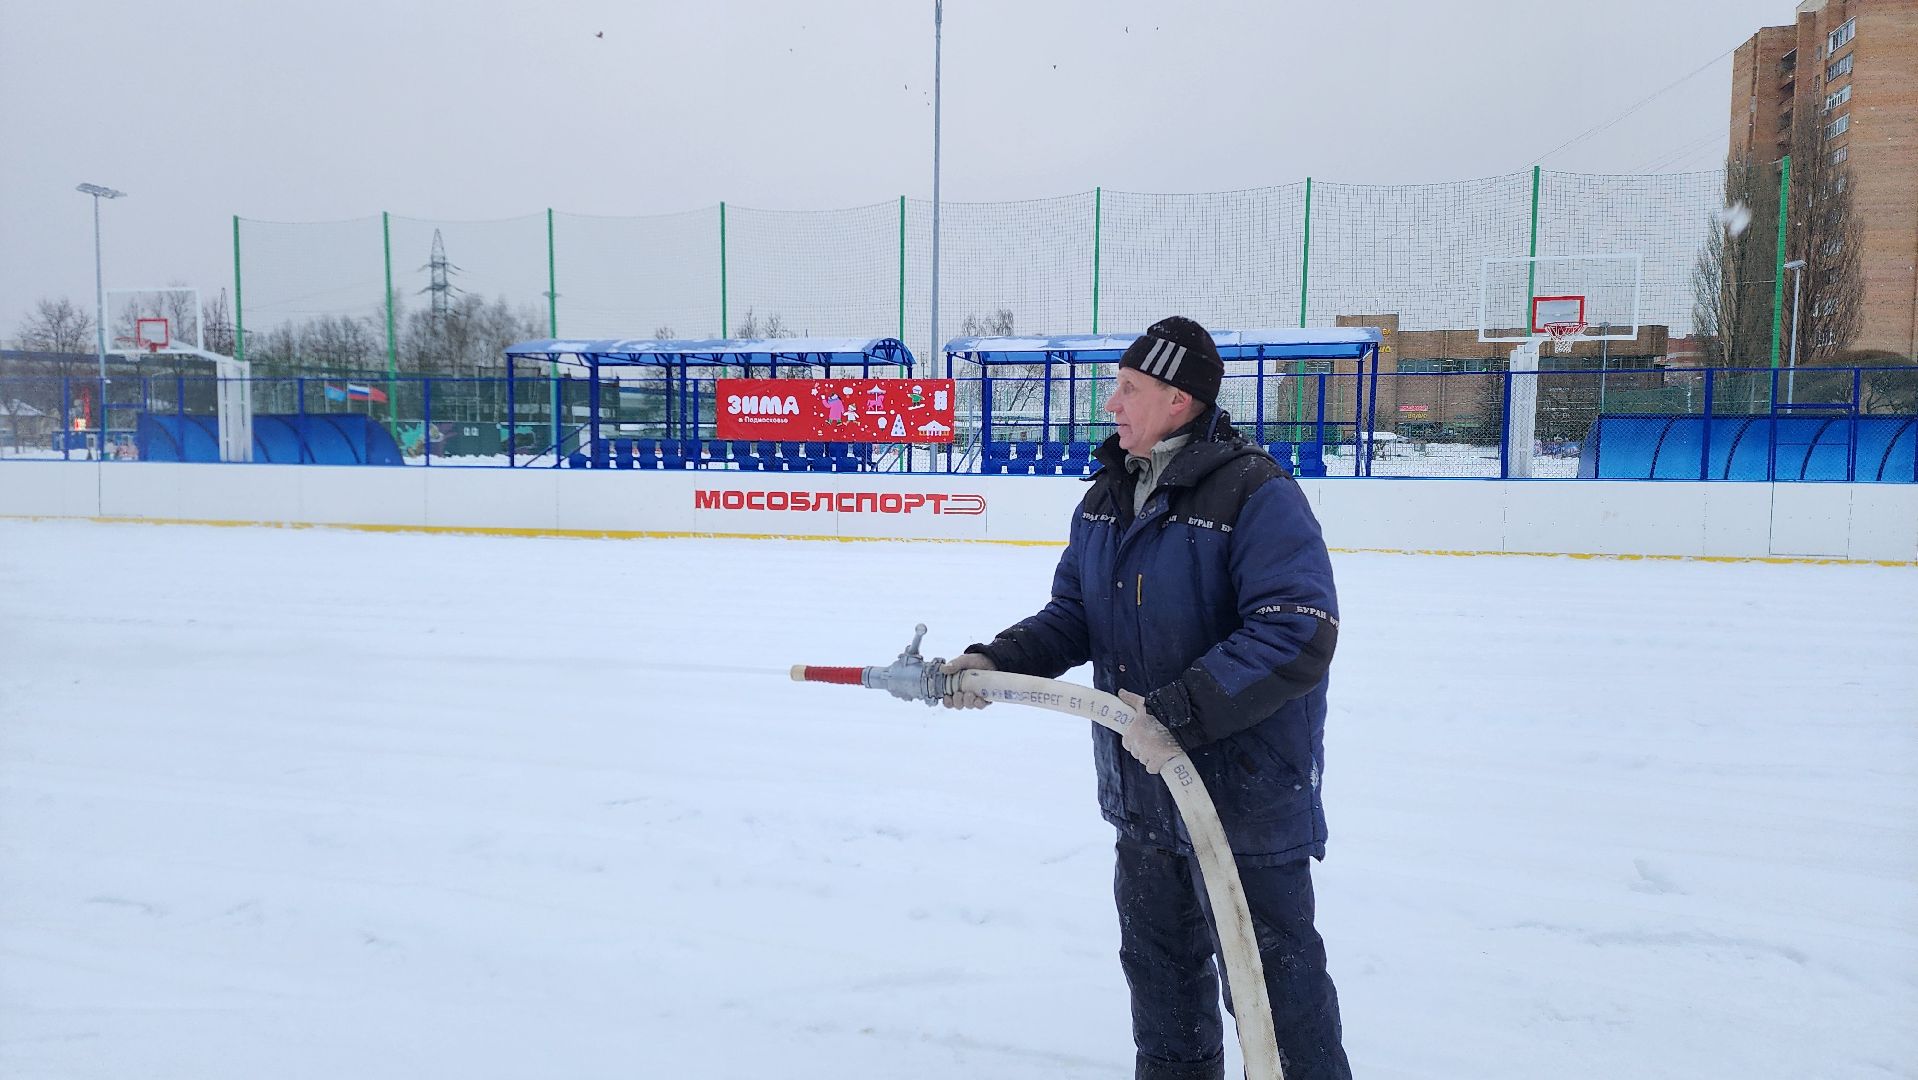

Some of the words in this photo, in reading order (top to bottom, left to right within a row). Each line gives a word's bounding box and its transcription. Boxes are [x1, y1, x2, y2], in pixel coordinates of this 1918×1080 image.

[727, 394, 799, 415] ЗИМА
[744, 415, 789, 424] Подмосковье
[695, 490, 951, 515] МОСОБЛСПОРТ
[1188, 516, 1215, 529] БУРАН
[1295, 605, 1328, 620] БУРАН
[1070, 696, 1082, 709] 51
